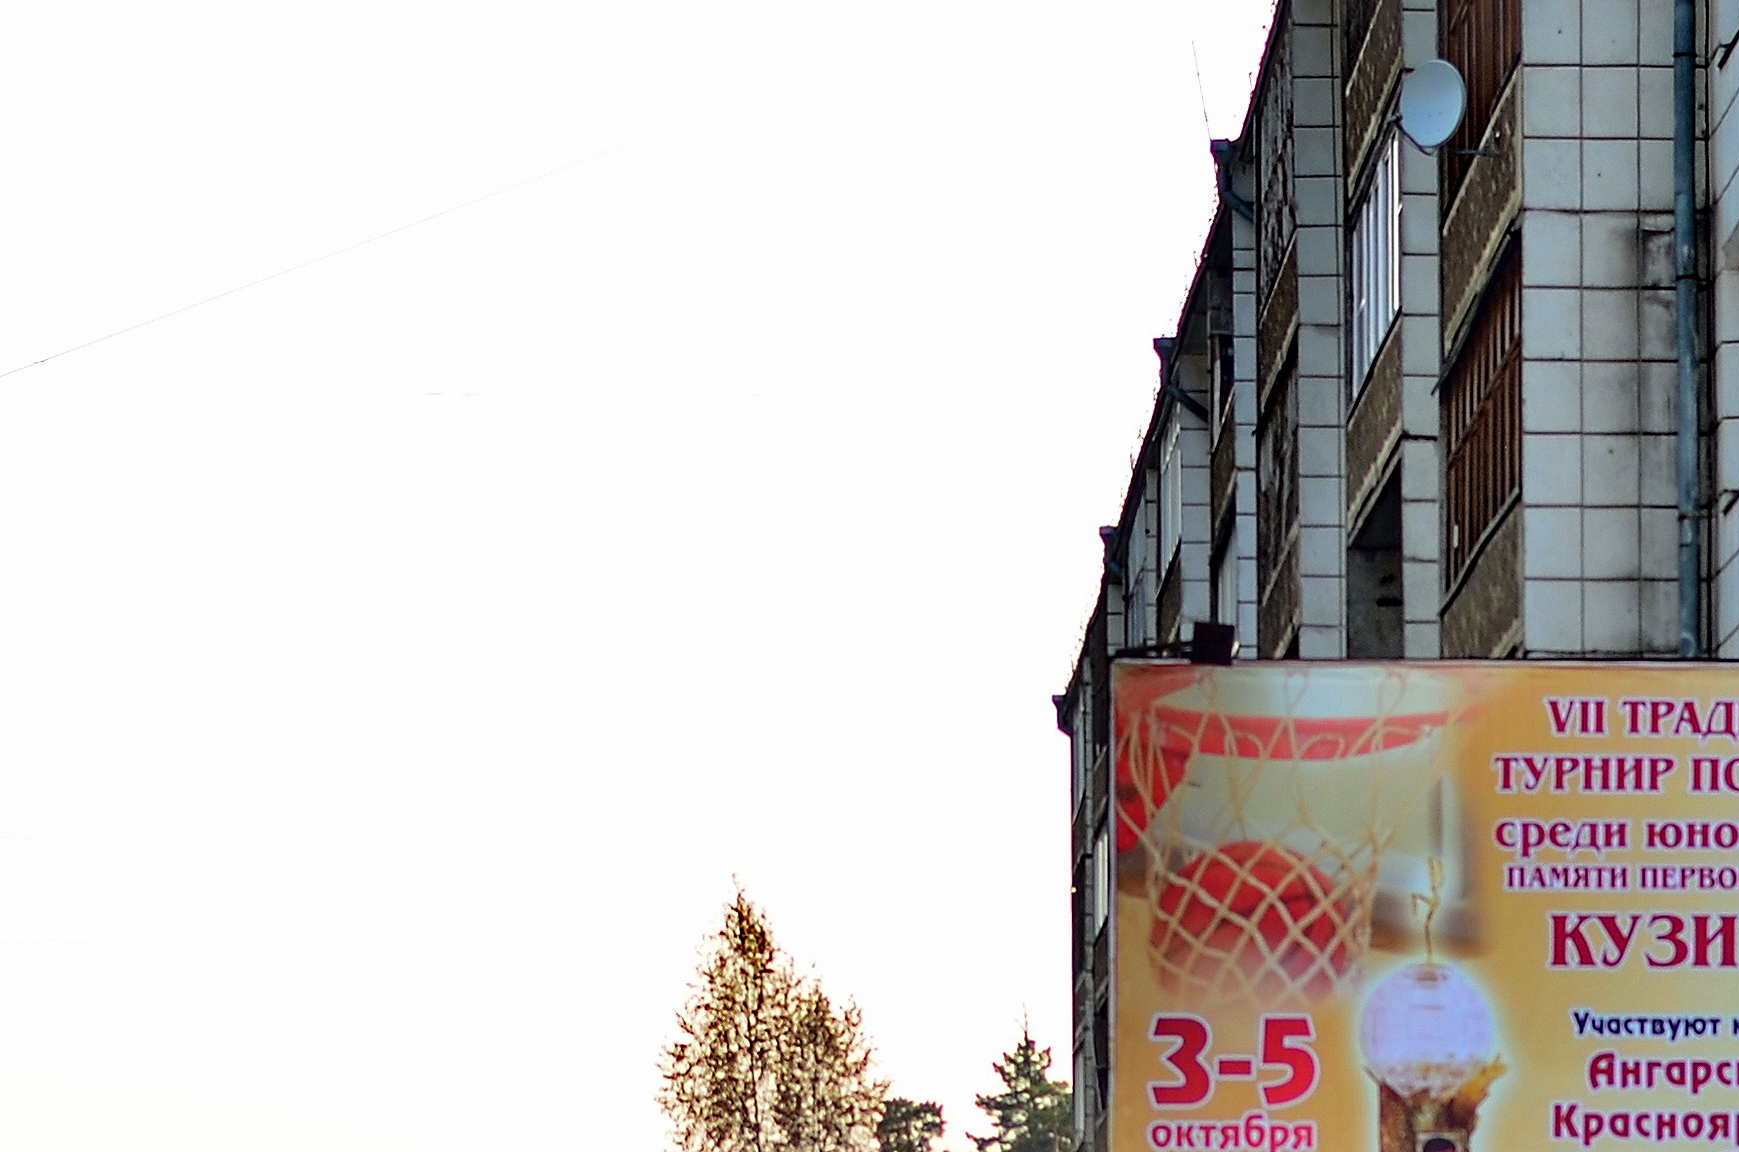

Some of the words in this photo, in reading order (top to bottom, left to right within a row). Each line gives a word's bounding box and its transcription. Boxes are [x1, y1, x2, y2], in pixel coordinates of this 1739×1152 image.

[1548, 700, 1605, 734] VII
[1494, 757, 1675, 791] ТУРНИР
[1495, 821, 1627, 858] среди
[1506, 866, 1628, 889] ПАМЯТИ
[1573, 1011, 1721, 1041] Участвуют
[1151, 1017, 1316, 1105] 3-5
